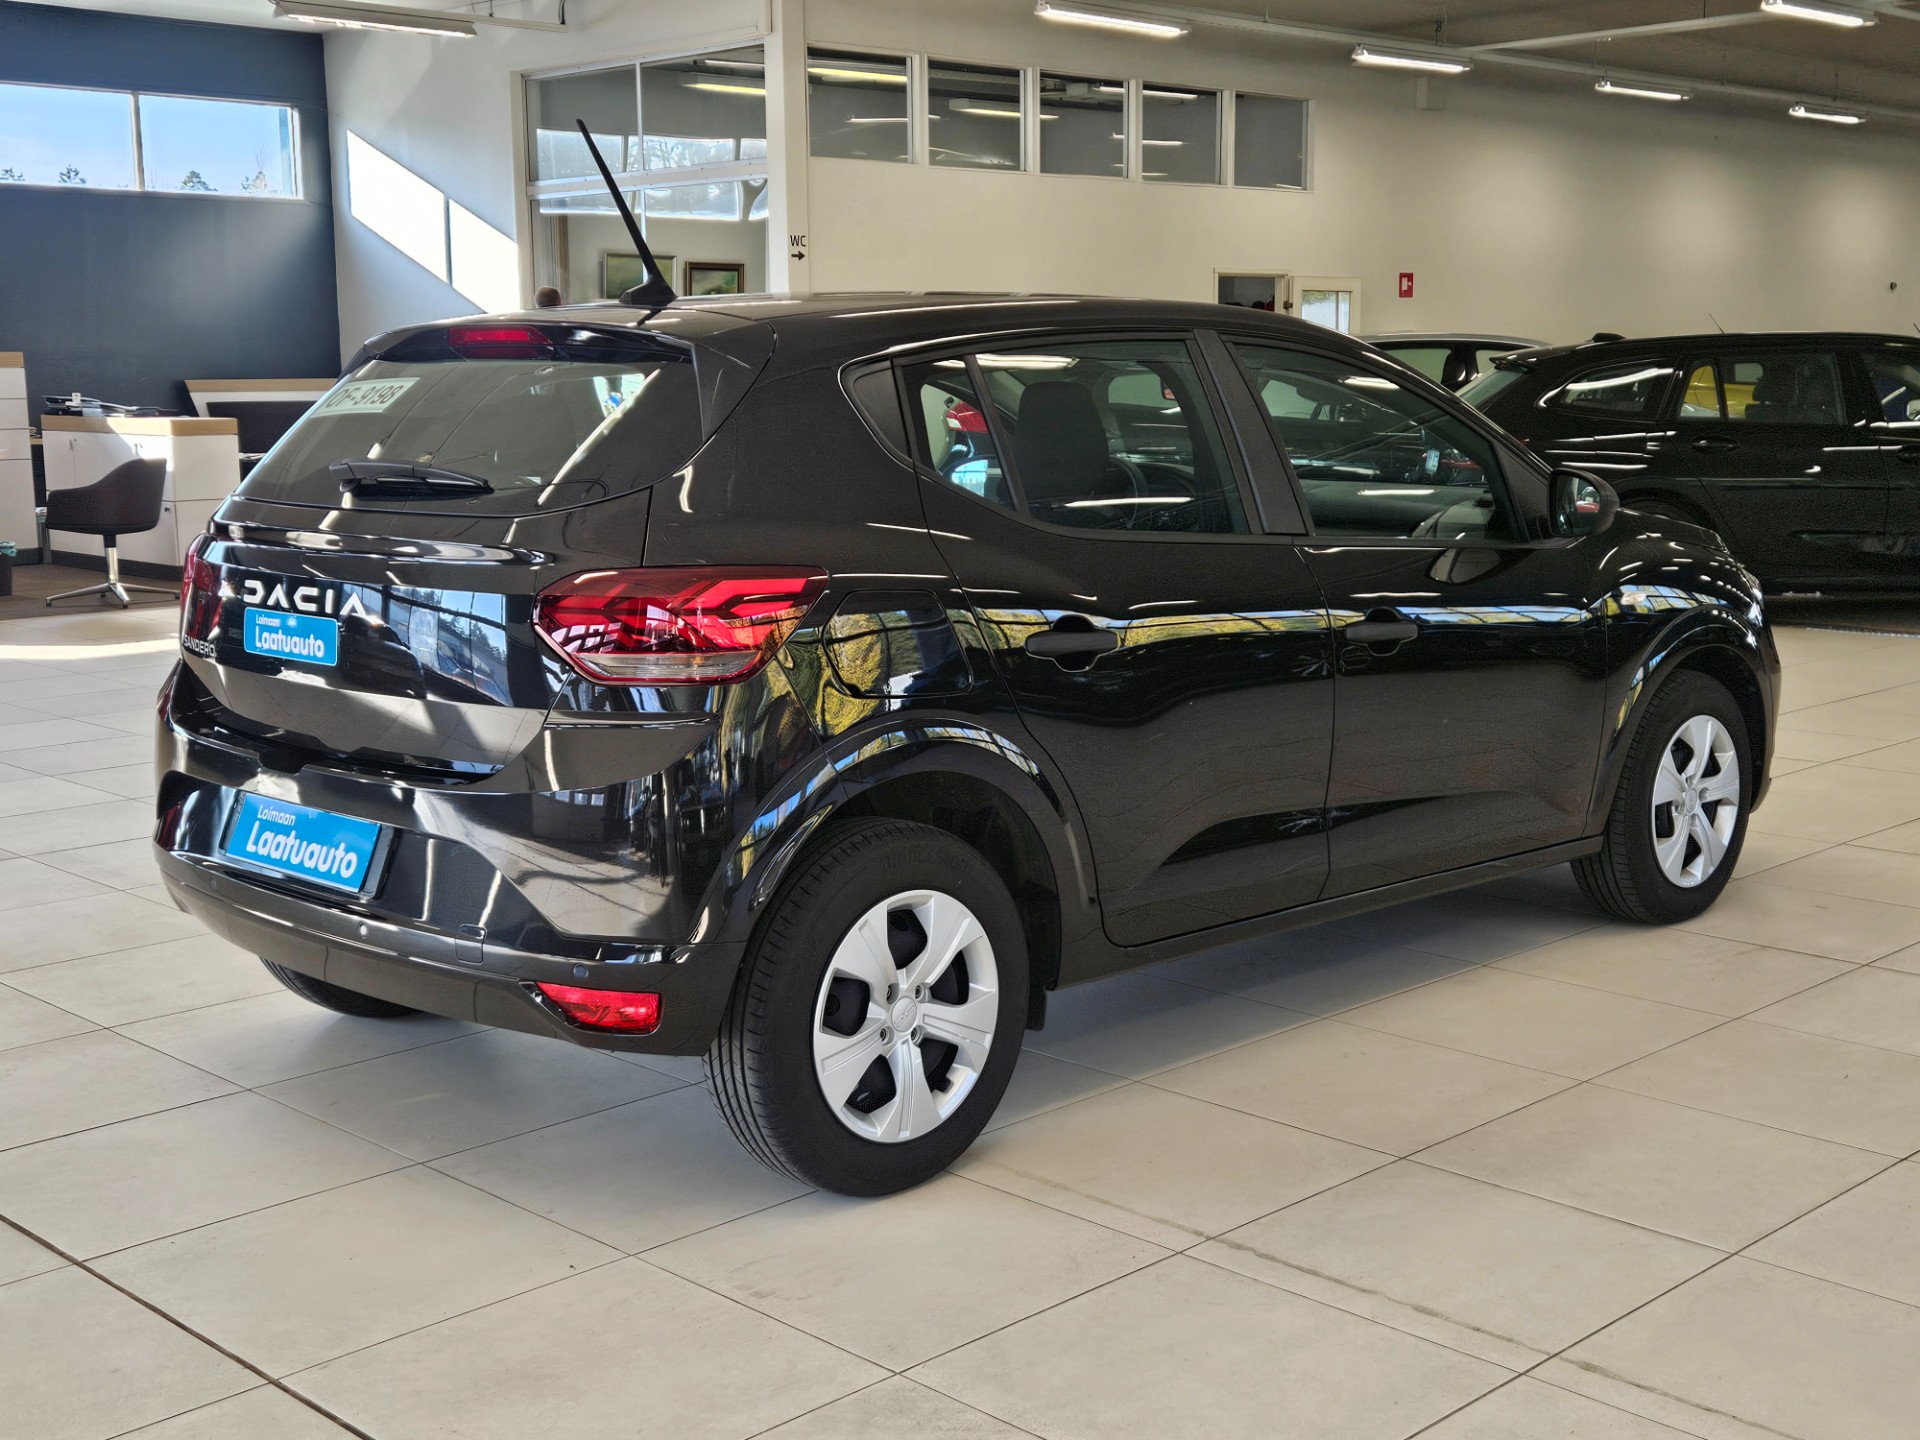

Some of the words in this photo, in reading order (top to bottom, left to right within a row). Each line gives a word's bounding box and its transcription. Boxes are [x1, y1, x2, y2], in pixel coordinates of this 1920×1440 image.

[789, 235, 806, 247] WC
[243, 579, 368, 616] DACIA
[256, 614, 281, 627] Loimaan
[255, 626, 325, 658] Laatuauto
[257, 805, 296, 826] Loimaan
[246, 821, 358, 878] Laatuauto
